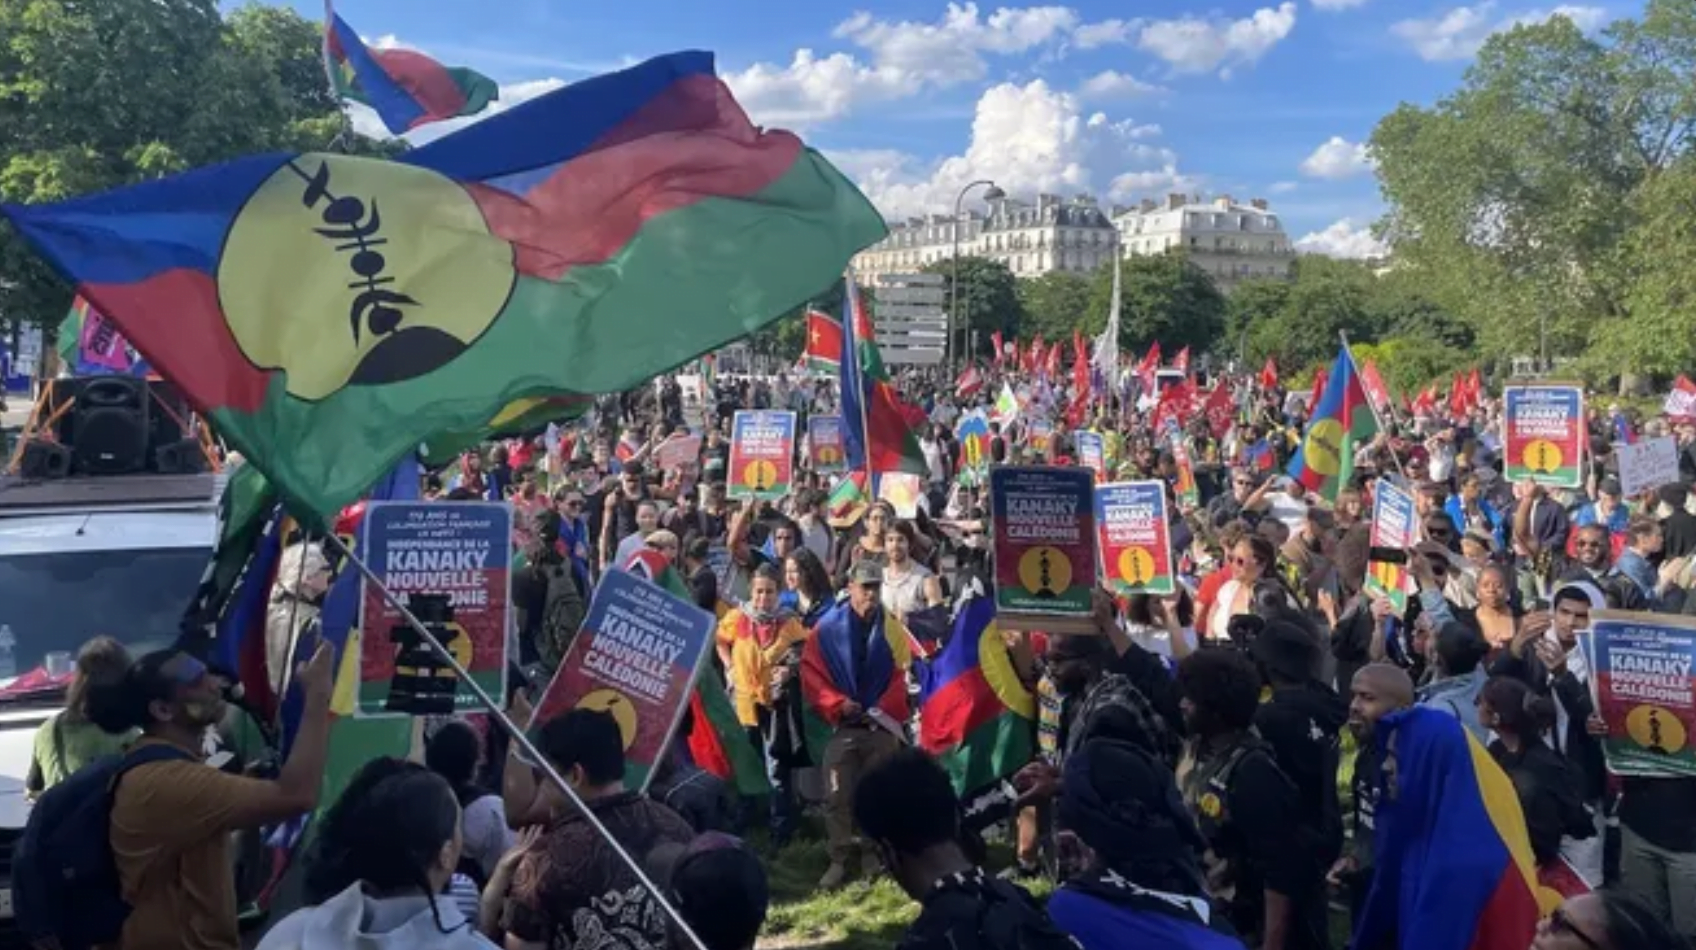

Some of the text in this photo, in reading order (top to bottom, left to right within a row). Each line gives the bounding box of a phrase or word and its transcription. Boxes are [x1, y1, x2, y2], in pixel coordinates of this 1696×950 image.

[1007, 498, 1078, 515] KANAKY
[477, 540, 490, 548] LA
[386, 551, 489, 571] KANAKY
[385, 571, 489, 590] NOUVELLE-
[599, 613, 684, 664] KANAKY
[591, 632, 673, 679] NOUVELLE-
[1610, 654, 1691, 677] KANAKY
[583, 650, 669, 699] CALÉDONIE
[1611, 671, 1692, 689] NOUVELLE-
[1611, 683, 1693, 703] CALÉDONIE
